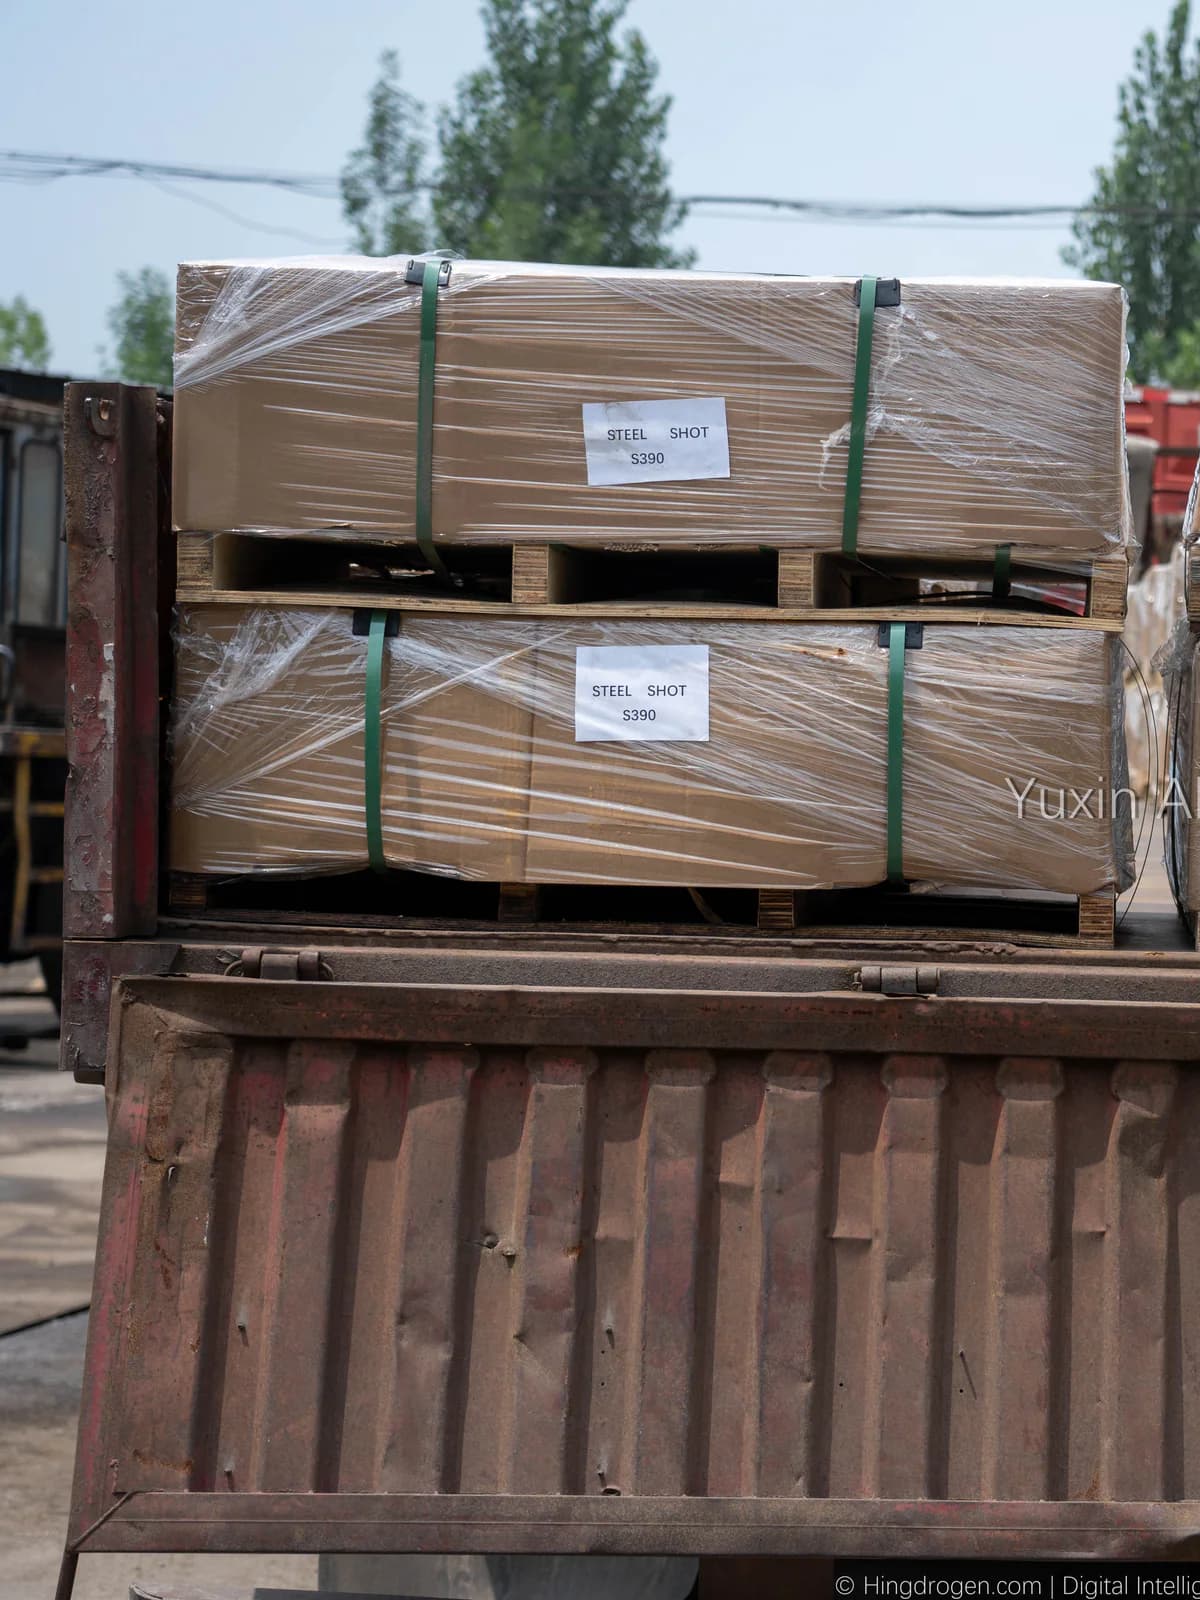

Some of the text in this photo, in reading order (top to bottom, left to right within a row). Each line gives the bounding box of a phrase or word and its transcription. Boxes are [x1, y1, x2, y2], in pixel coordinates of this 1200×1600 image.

[607, 426, 709, 441] STEEL SHOT
[631, 452, 665, 465] S390
[592, 685, 687, 697] STEEL SHOT
[622, 709, 656, 721] S390
